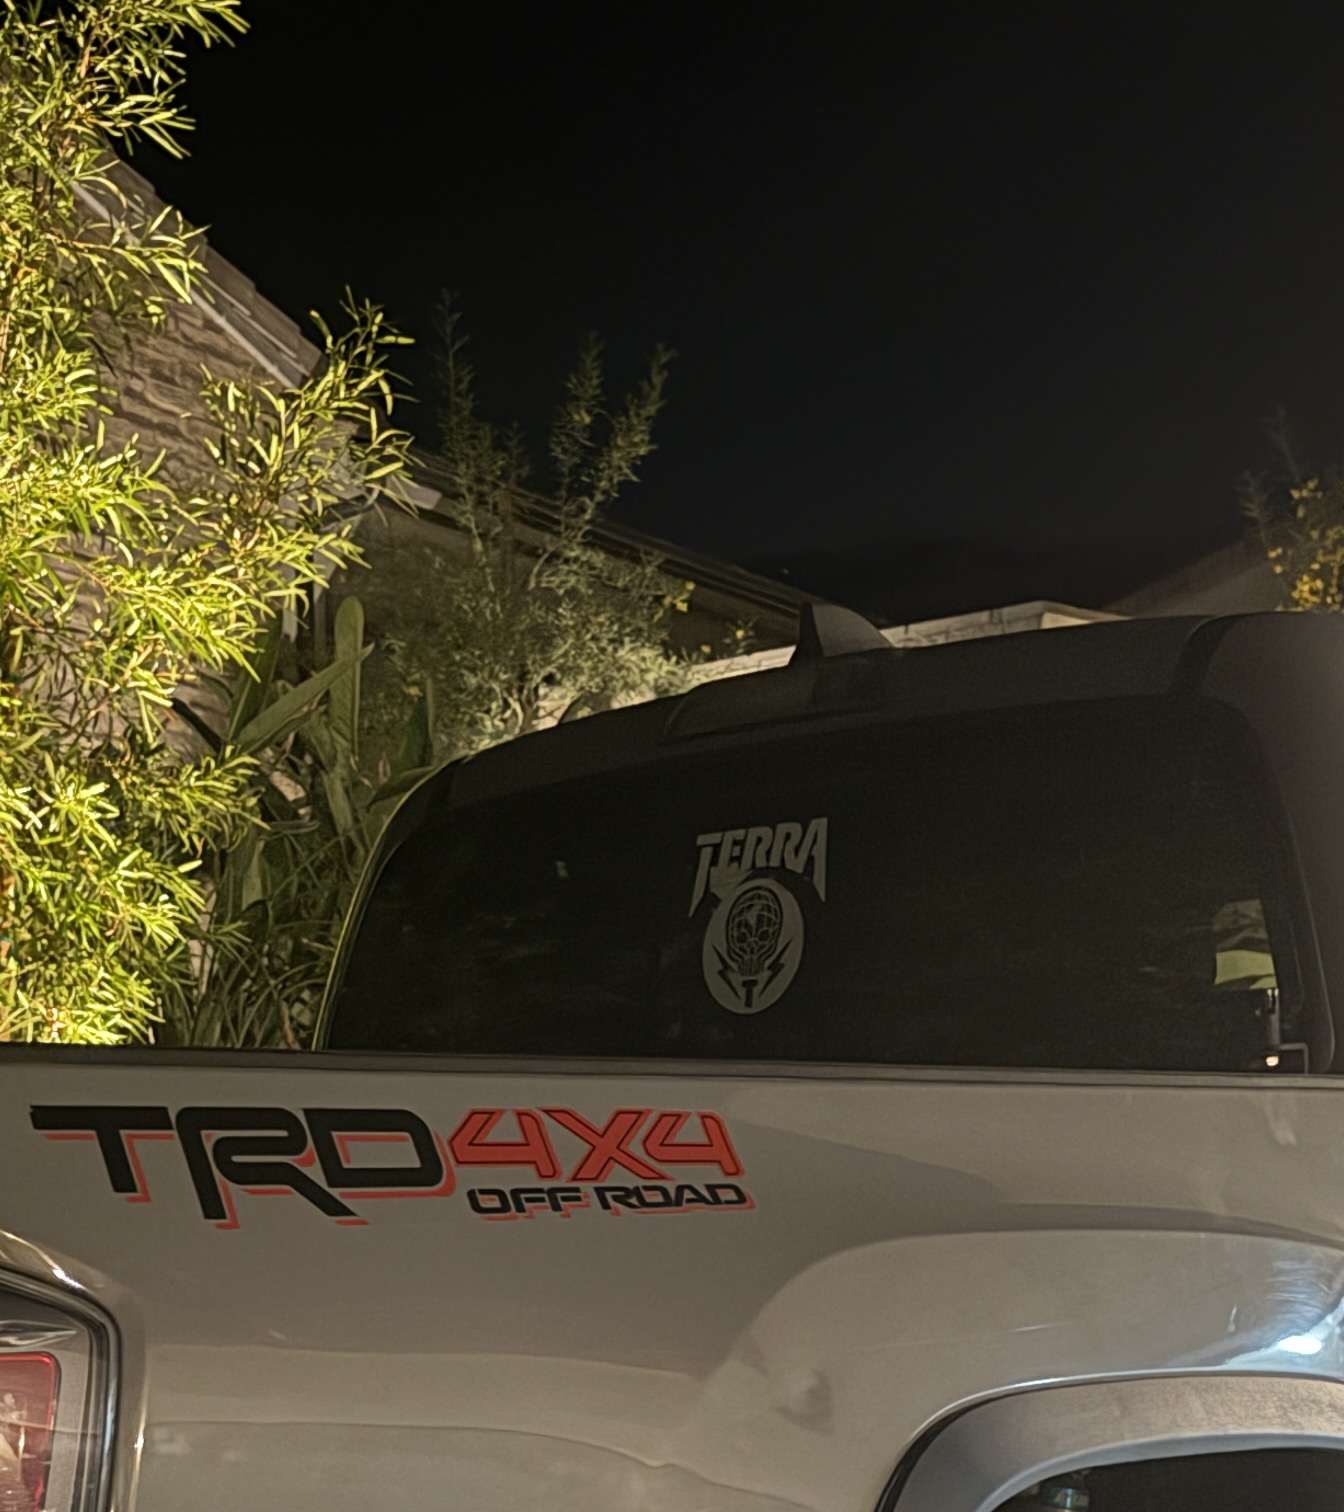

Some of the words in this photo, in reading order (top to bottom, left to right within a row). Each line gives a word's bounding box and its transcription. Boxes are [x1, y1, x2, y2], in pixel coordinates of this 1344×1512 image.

[688, 816, 828, 919] TERRA
[29, 1104, 456, 1230] TRD
[469, 1187, 582, 1221] OFF
[594, 1183, 755, 1216] ROAD
